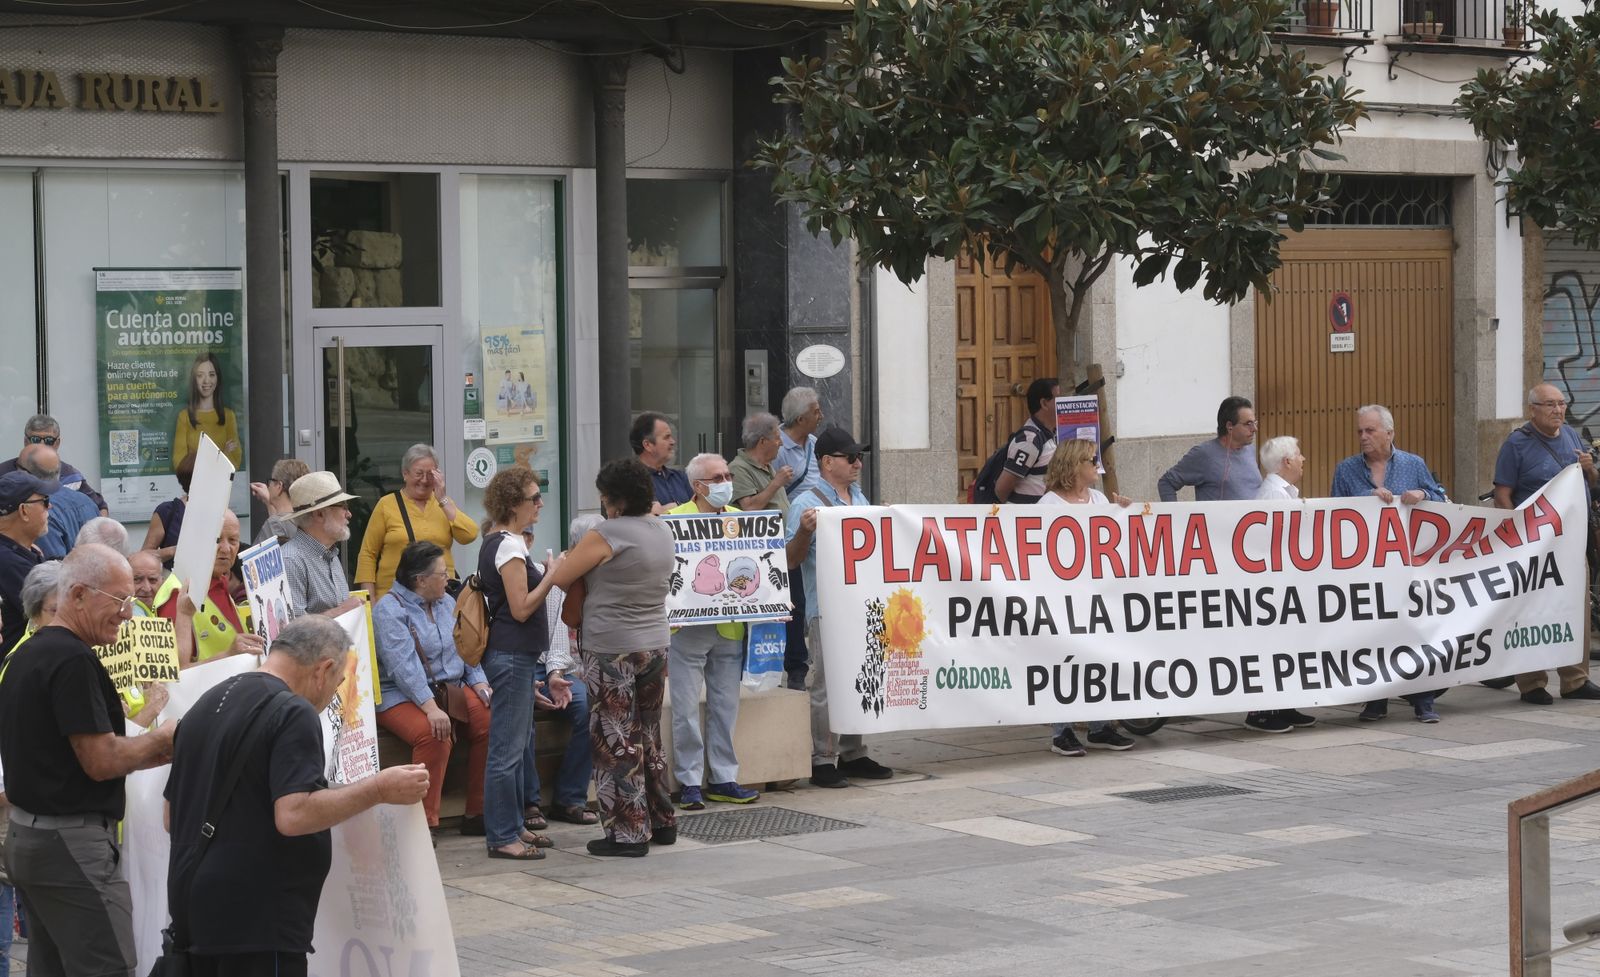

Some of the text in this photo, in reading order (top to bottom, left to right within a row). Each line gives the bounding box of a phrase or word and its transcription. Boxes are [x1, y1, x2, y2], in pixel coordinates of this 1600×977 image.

[79, 71, 224, 113] RURAL
[106, 307, 234, 328] Cuenta online
[118, 327, 224, 346] autónomos
[485, 334, 509, 347] 95%
[107, 360, 155, 370] Hazte cliente
[107, 369, 178, 381] online y disfruta de
[107, 382, 156, 391] una cuenta
[107, 390, 177, 403] para autónomos
[1056, 401, 1098, 410] MANIFESTACIÓN
[1015, 452, 1026, 466] 2
[118, 482, 158, 493] 1. 2.
[680, 538, 765, 553] LAS PENSIONES
[841, 493, 1564, 585] PLATAFORMA CIUDADANA
[255, 547, 284, 586] BUSCAN
[948, 550, 1565, 639] PARA LA DEFENSA DEL SISTEMA
[668, 602, 789, 619] IMPIDAMOS QUE LAS ROBEN
[141, 620, 172, 633] COTIZO
[121, 627, 130, 640] LA
[140, 634, 175, 649] COTIZAS
[92, 640, 131, 659] CASION
[888, 650, 923, 660] Plataforma
[135, 652, 170, 664] Y ELLOS
[887, 659, 920, 669] Ciudadana
[936, 621, 1575, 707] CÓRDOBA PÚBLICO DE PENSIONES CÓRDOBA
[888, 667, 930, 678] para la Defensa
[895, 677, 918, 686] Sistema
[911, 686, 920, 695] de
[886, 695, 919, 708] Pensiones
[365, 761, 373, 772] de
